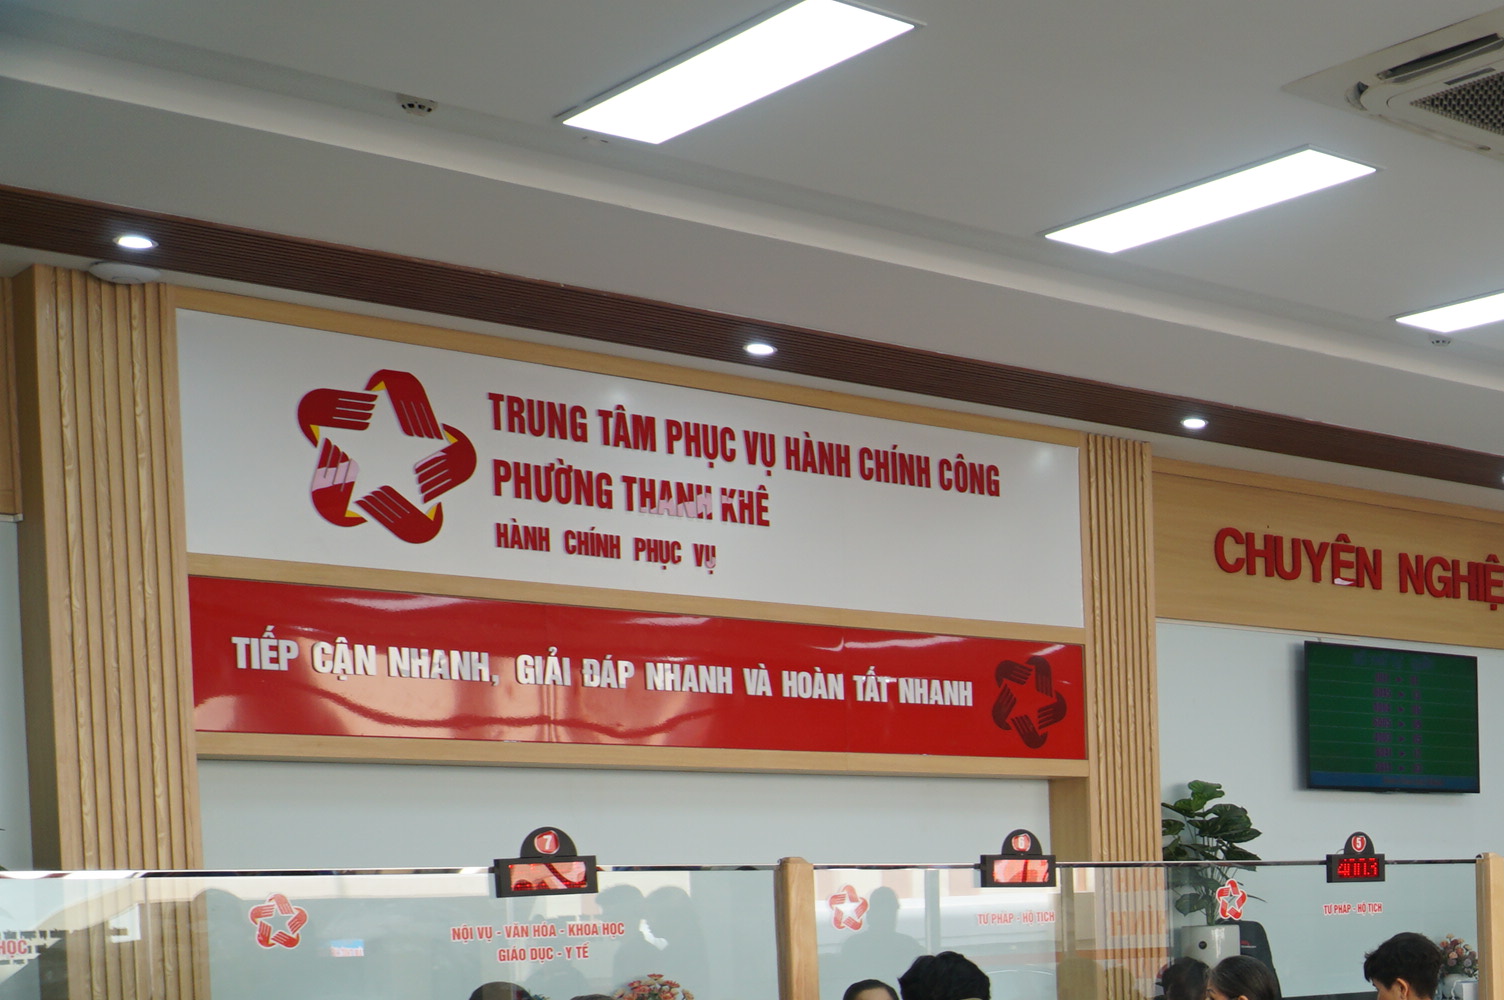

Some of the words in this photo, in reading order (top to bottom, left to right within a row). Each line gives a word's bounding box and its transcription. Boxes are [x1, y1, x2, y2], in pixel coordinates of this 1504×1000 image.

[488, 392, 588, 442] TRUNG
[598, 404, 656, 452] TÂM
[666, 419, 736, 468] PHỤC
[743, 430, 776, 476] VỤ
[785, 431, 851, 478] HÀNH
[859, 444, 931, 488] CHÍNH
[939, 453, 1000, 497] CÔNG
[492, 458, 613, 509] PHƯỜNG
[621, 475, 712, 520] THANH
[720, 485, 770, 526] KHÊ
[495, 518, 550, 552] HÀNH
[563, 527, 621, 559] CHÍNH
[633, 537, 682, 570] PHỤC
[692, 543, 716, 575] VỤ
[1214, 527, 1382, 590] CHUYÊN
[231, 625, 299, 671] TIẾP
[312, 636, 376, 681] CẬN
[387, 646, 500, 686] NHANH,
[515, 647, 571, 686] GIẢI
[582, 655, 635, 689] ĐÁP
[645, 661, 733, 694] NHANH
[743, 663, 772, 697] VÀ
[781, 667, 844, 700] HOÀN
[853, 666, 891, 703] TẤT
[898, 677, 973, 706] NHANH
[543, 835, 552, 850] 7
[1018, 836, 1025, 849] 6
[1356, 837, 1362, 849] 5
[991, 911, 1014, 924] PHÁP
[1022, 910, 1034, 926] HỘ
[1036, 911, 1055, 925] TỊCH
[1333, 902, 1352, 914] PHÁP
[1357, 900, 1366, 916] HỘ
[1367, 903, 1382, 915] TỊCH
[451, 925, 474, 943] NỘI
[477, 926, 493, 943] VỤ
[504, 922, 529, 938] VĂN
[533, 922, 557, 938] HÓA
[568, 923, 599, 937] KHOA
[602, 922, 625, 939] HỌC
[498, 945, 526, 962] GIÁO
[530, 946, 554, 963] DỤC
[565, 947, 573, 959] Y
[576, 943, 589, 959] TẾ
